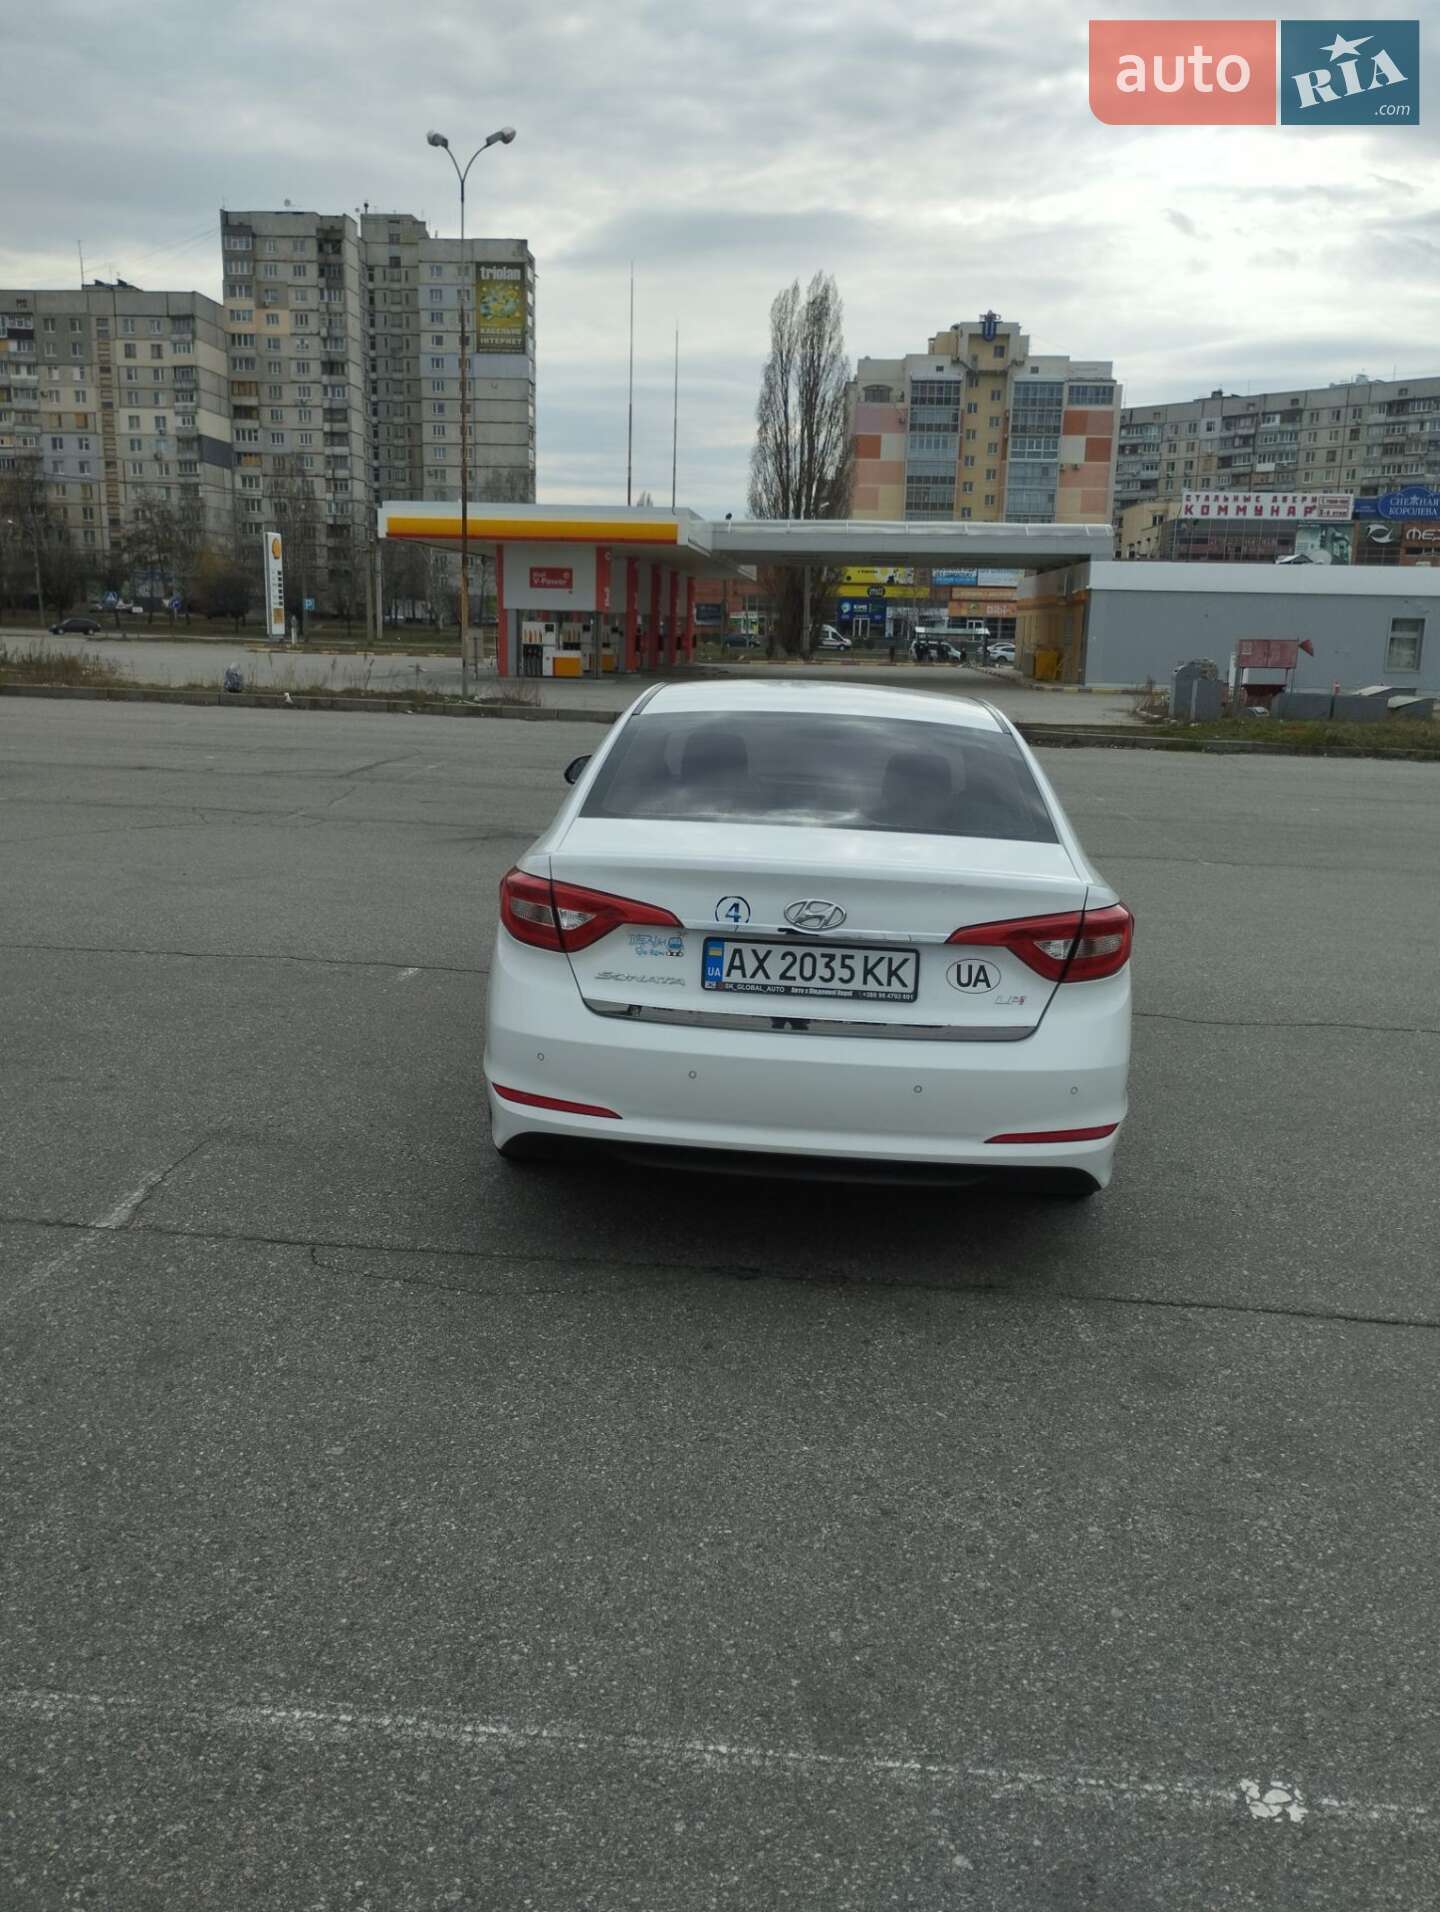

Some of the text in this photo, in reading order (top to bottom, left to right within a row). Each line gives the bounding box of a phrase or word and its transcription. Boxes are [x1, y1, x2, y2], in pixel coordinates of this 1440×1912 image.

[1185, 494, 1261, 503] СТАЛЬНЫЕ
[1272, 495, 1318, 504] ДВЕРИ
[1390, 497, 1439, 506] СНЕЖНАЯ
[1184, 504, 1314, 516] КОММУНАР
[1389, 507, 1438, 516] КОРОЛЕВА
[725, 902, 742, 922] 4
[708, 948, 911, 988] UA AX 2035 KK
[956, 964, 991, 988] UA
